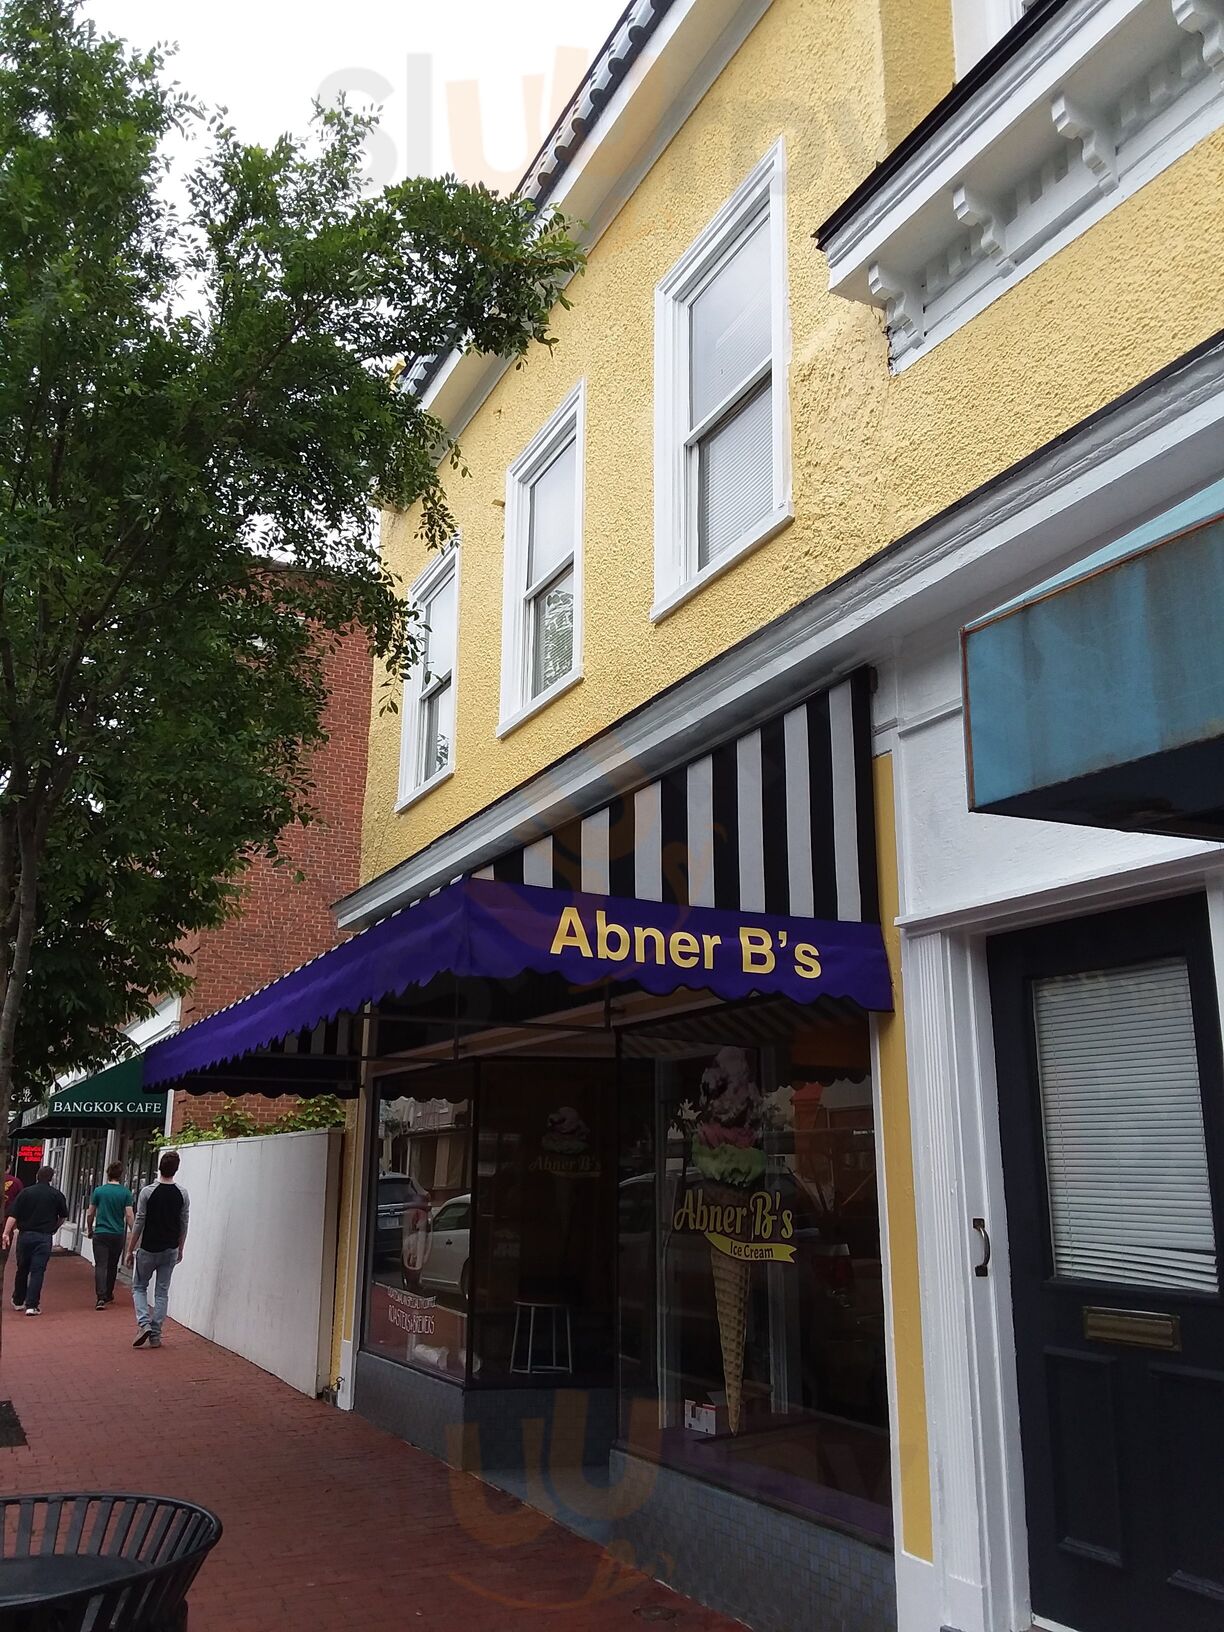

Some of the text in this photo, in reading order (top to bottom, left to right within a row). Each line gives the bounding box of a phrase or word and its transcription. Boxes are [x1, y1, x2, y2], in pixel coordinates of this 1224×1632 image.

[550, 906, 822, 979] Abner B's
[53, 1101, 162, 1114] BANGKOK CAFE
[673, 1188, 794, 1239] Abner B's
[730, 1241, 774, 1260] Ice Cream
